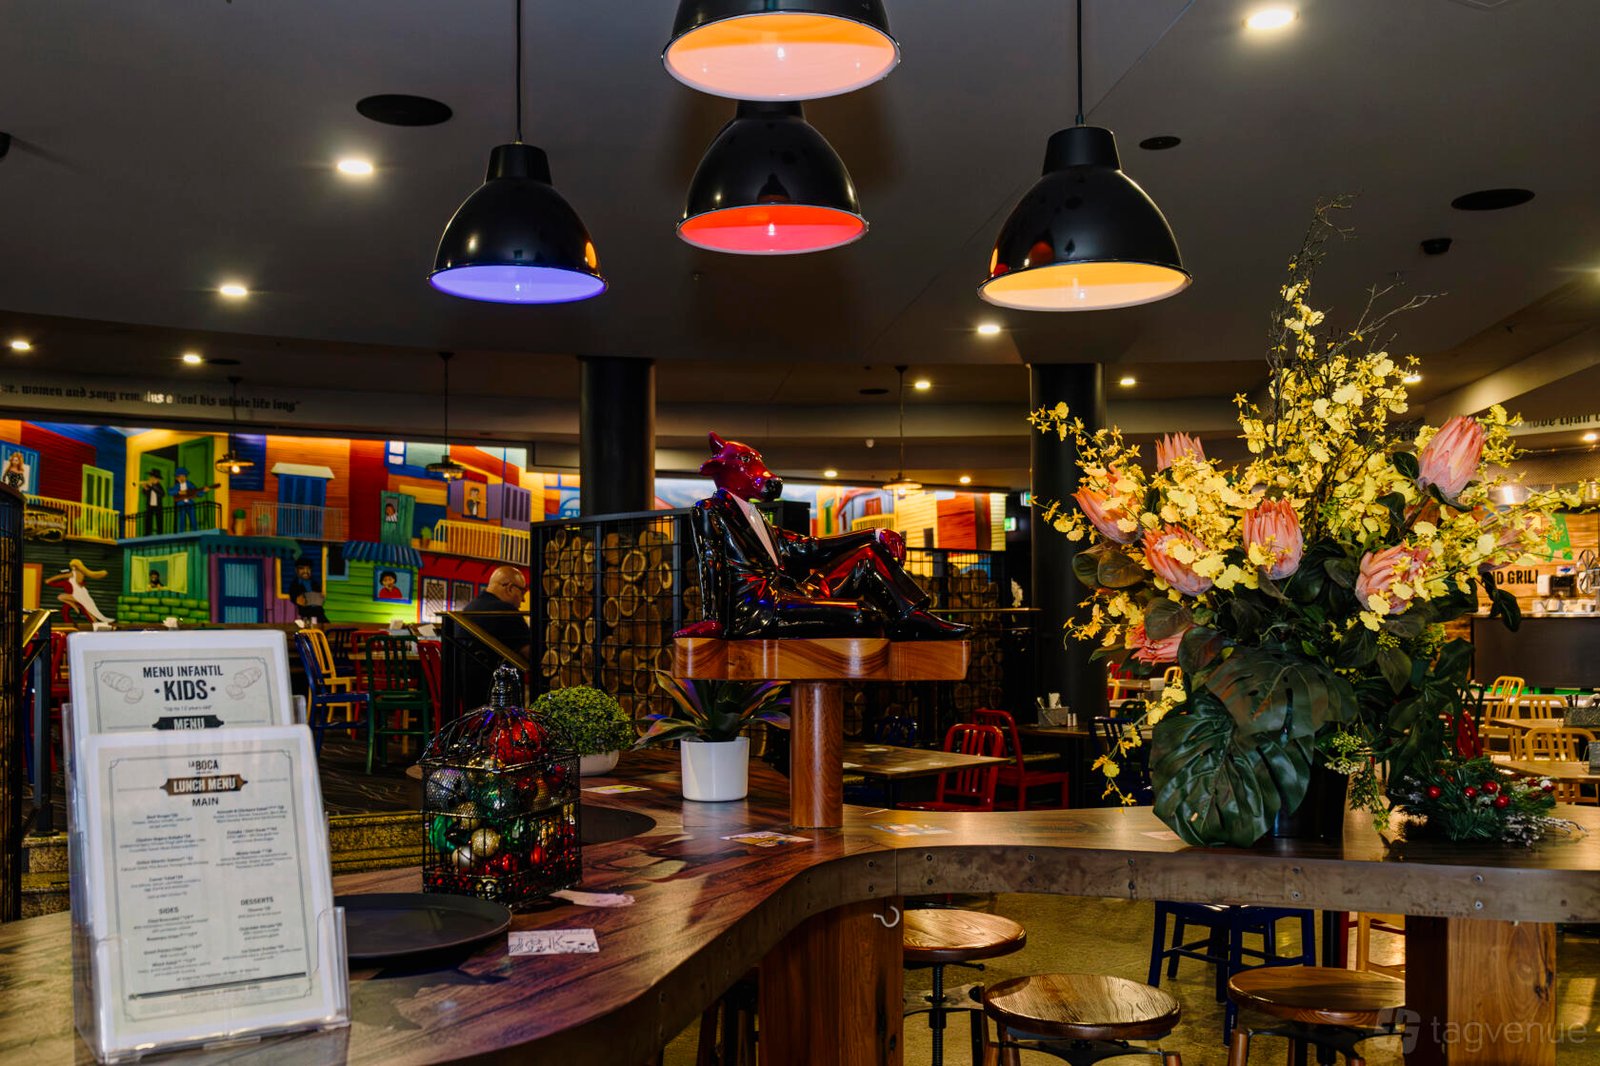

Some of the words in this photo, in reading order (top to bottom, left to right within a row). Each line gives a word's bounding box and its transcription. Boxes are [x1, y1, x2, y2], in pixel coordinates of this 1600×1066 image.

[66, 387, 86, 397] and
[143, 667, 173, 678] MENU
[177, 665, 223, 677] INFANTIL
[164, 680, 208, 701] KIDS
[173, 717, 205, 729] MENU
[173, 779, 206, 793] LUNCH
[207, 777, 236, 791] MENU
[192, 797, 219, 807] MAIN
